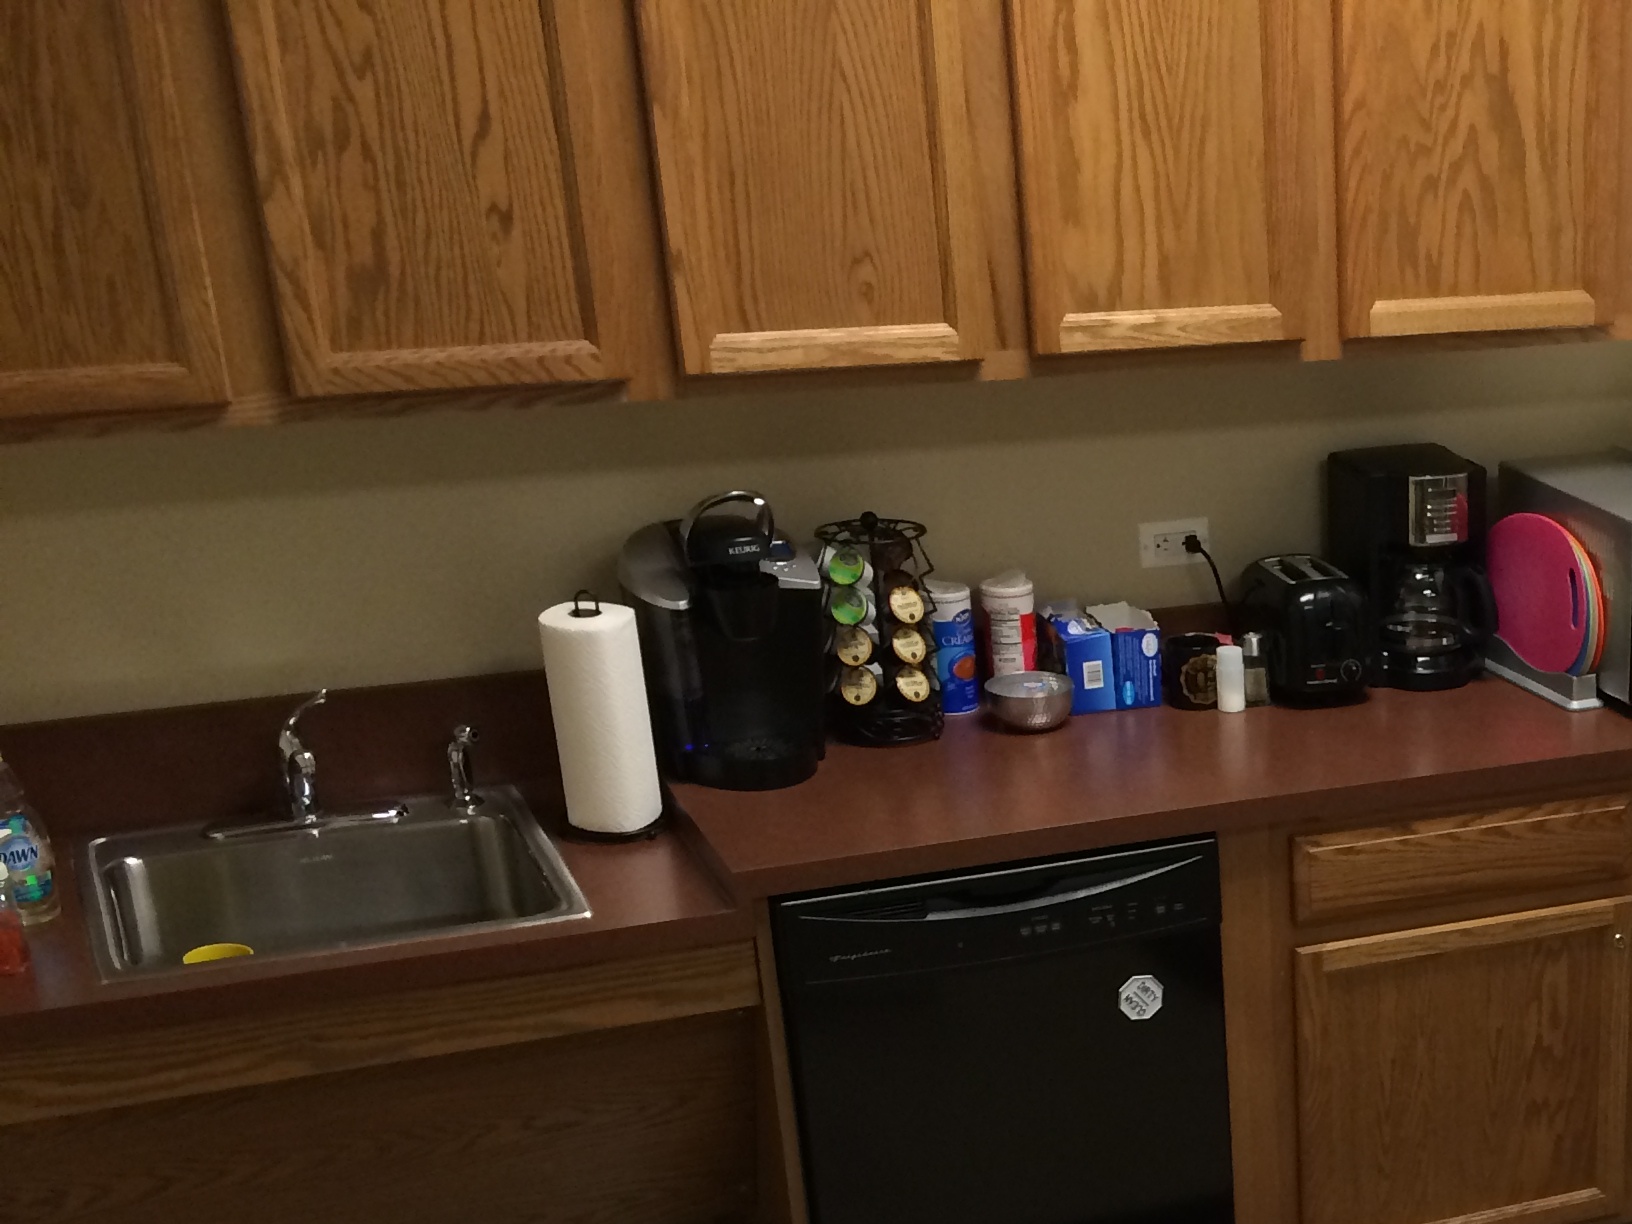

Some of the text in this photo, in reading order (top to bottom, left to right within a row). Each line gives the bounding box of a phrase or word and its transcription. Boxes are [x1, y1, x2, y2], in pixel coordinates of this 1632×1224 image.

[728, 544, 760, 555] KEURIG
[0, 844, 38, 865] DAWN
[1137, 981, 1159, 1002] DIRTY
